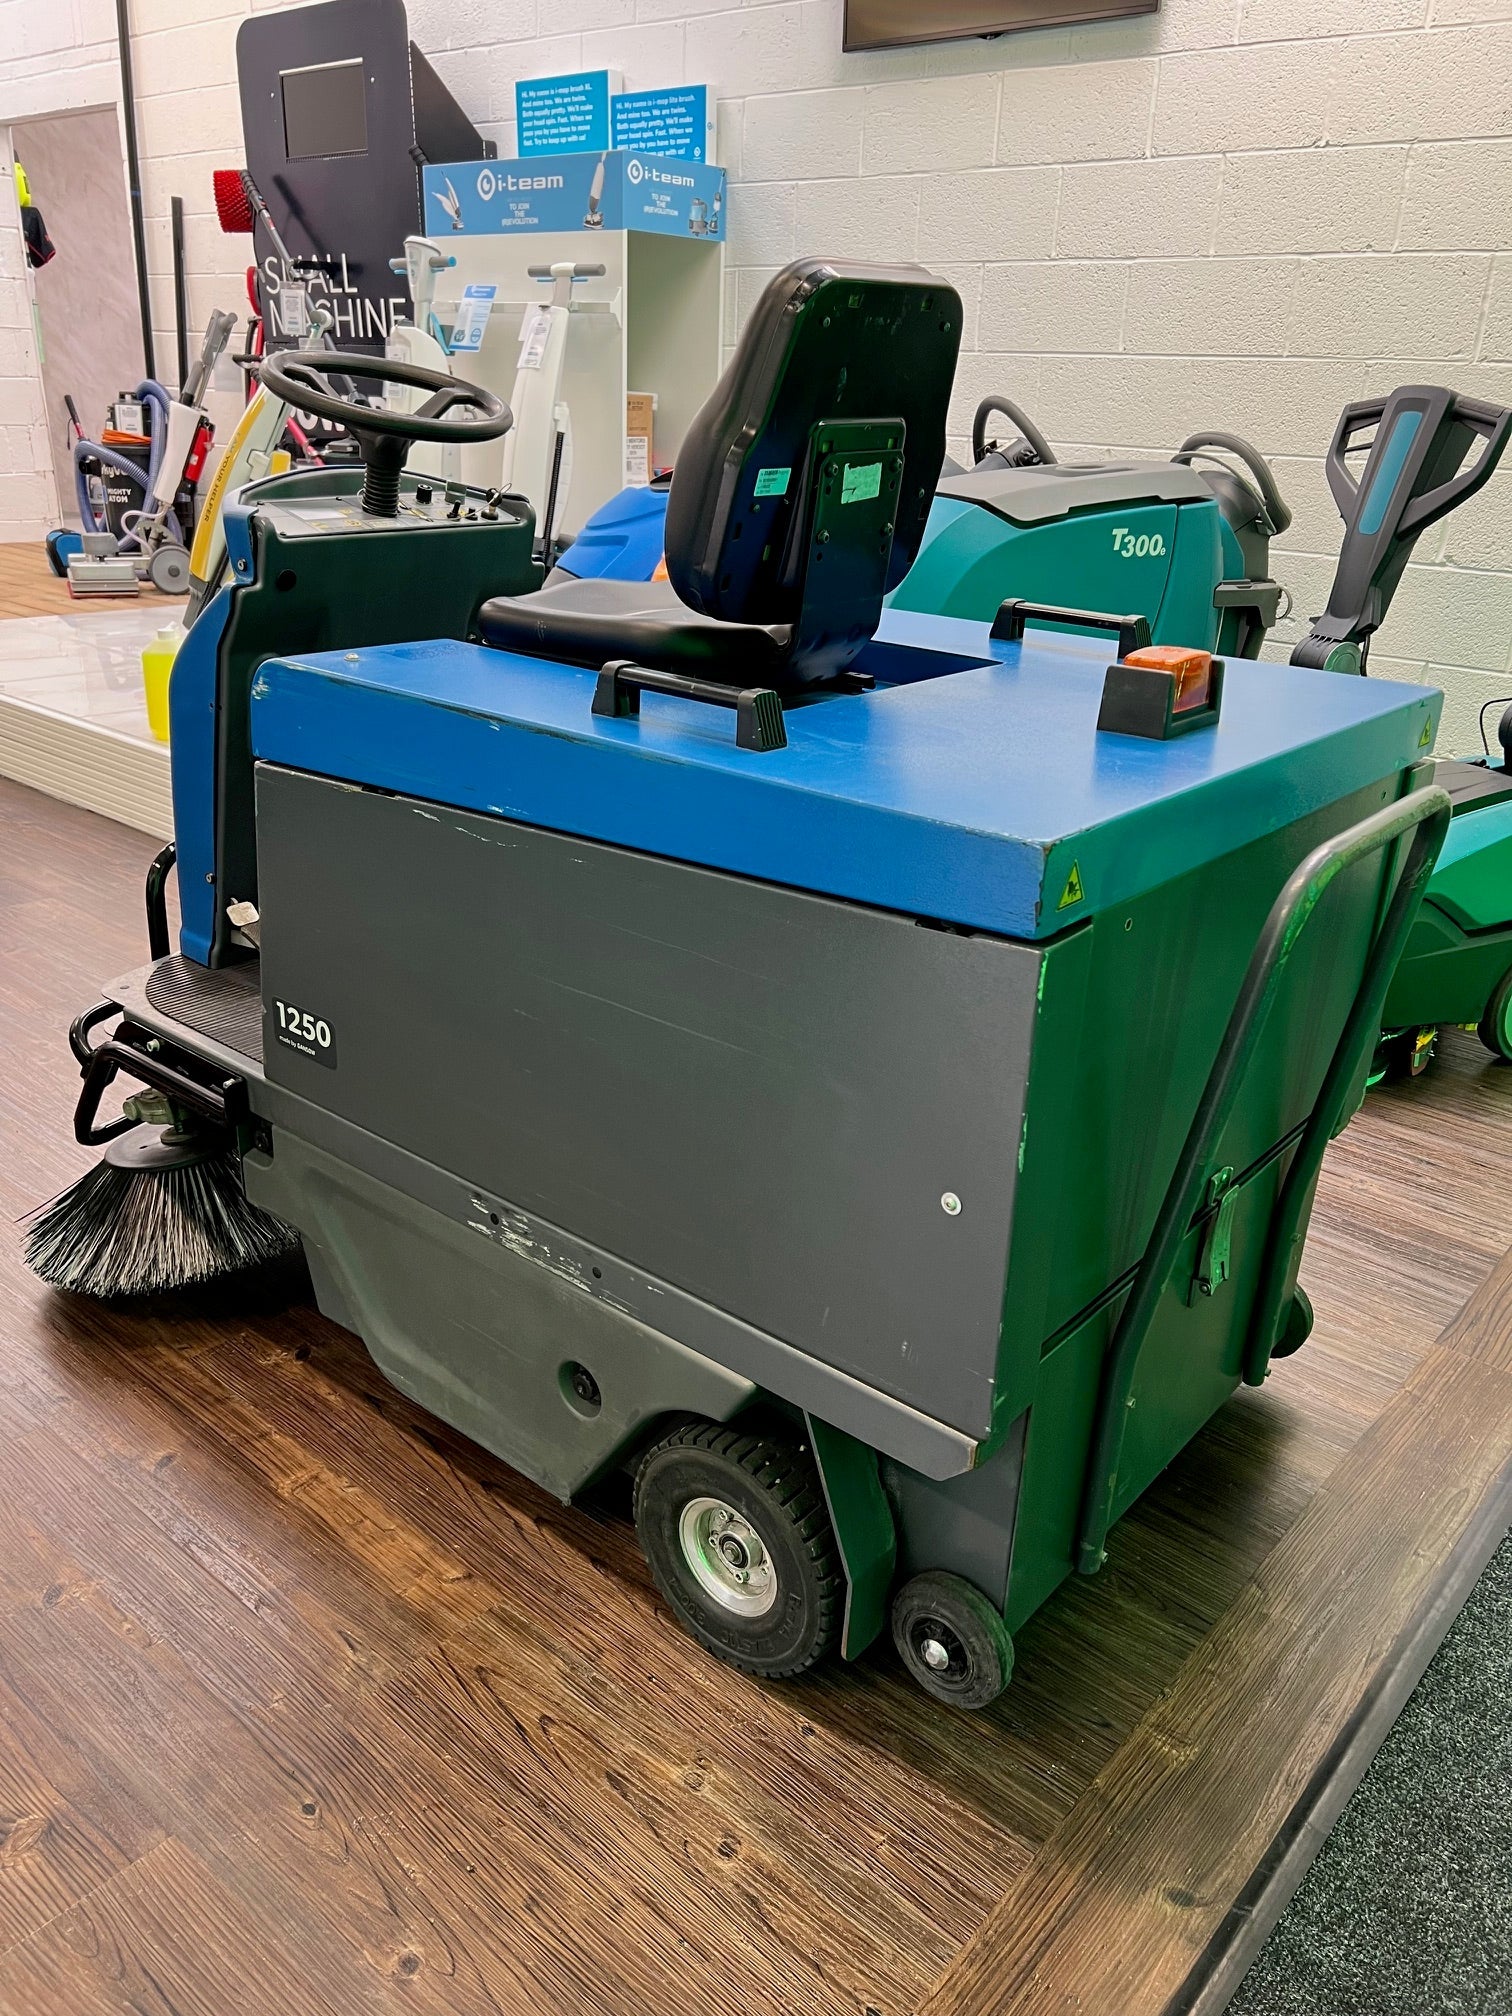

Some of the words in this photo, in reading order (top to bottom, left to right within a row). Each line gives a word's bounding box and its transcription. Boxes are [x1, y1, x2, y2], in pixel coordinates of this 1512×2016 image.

[534, 108, 550, 116] equally
[630, 121, 647, 129] equally
[217, 455, 230, 482] YOUR
[108, 495, 129, 503] ATOM
[204, 484, 220, 521] HELPER
[277, 1001, 331, 1048] 1250
[291, 1039, 296, 1048] by
